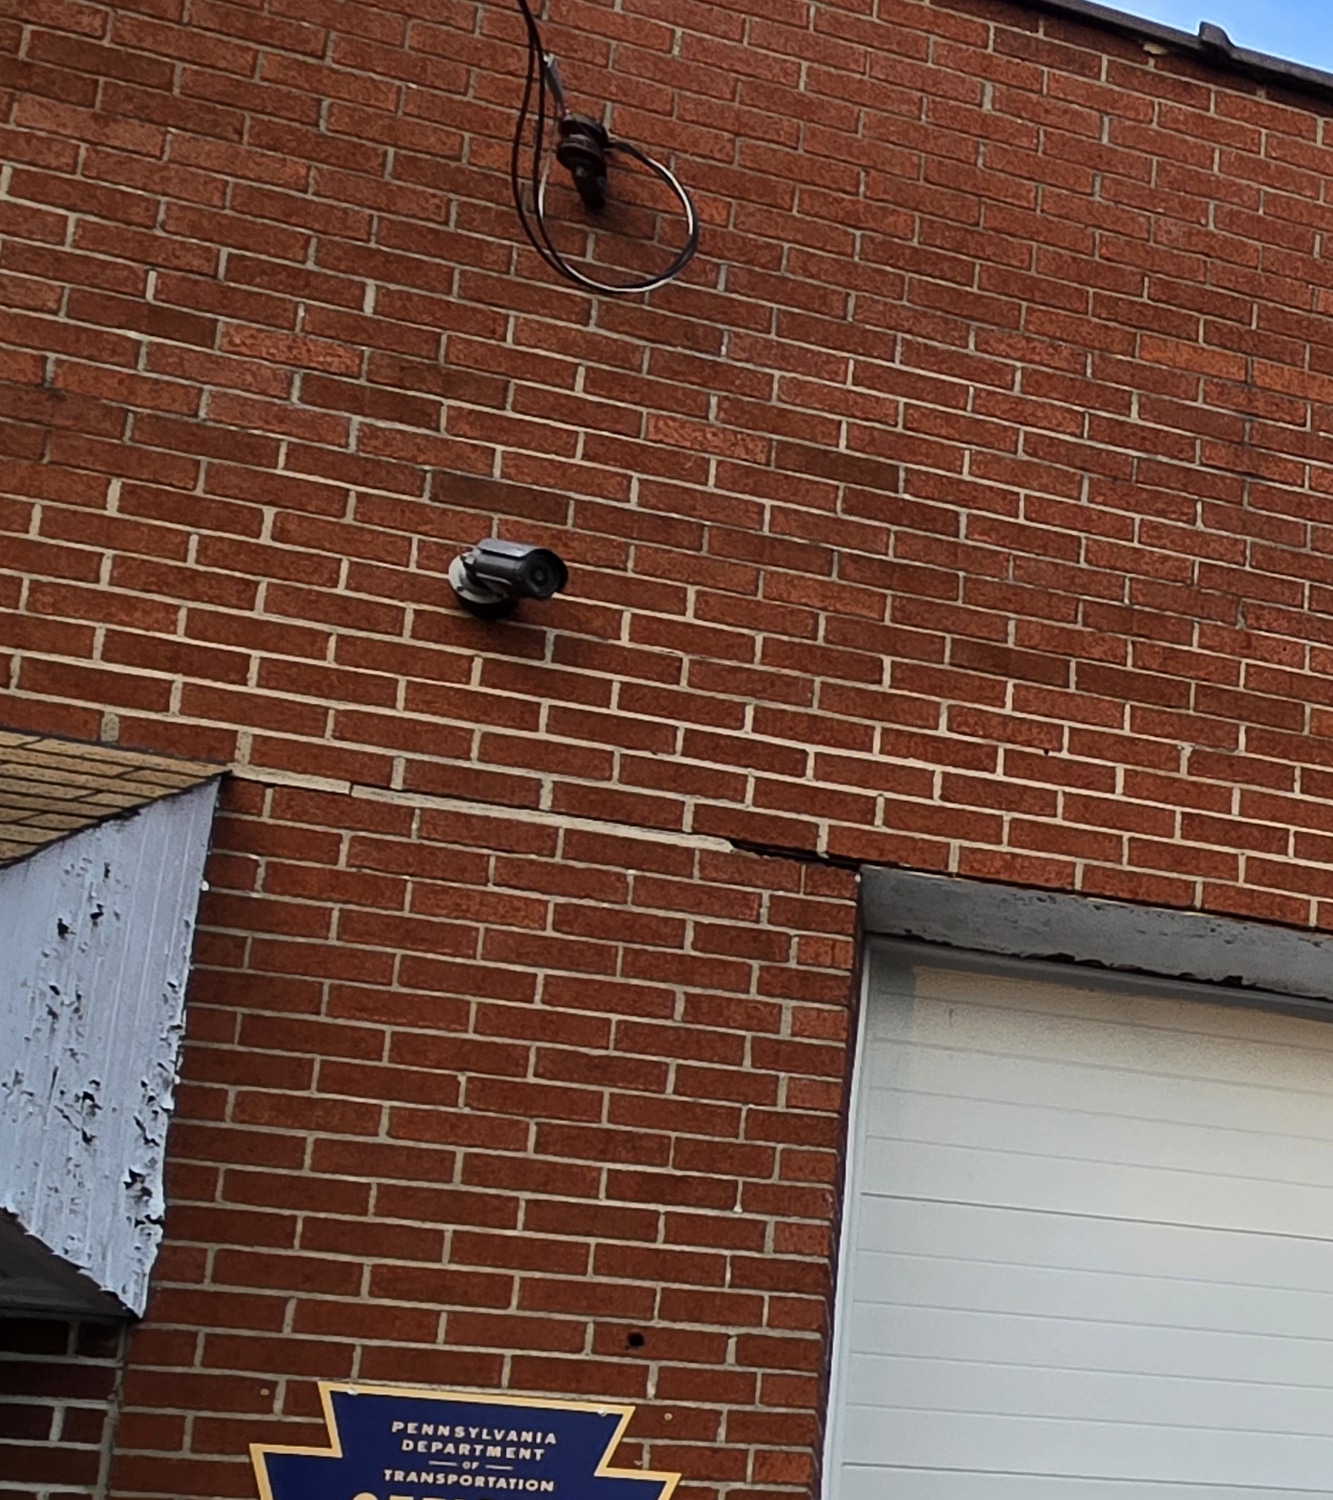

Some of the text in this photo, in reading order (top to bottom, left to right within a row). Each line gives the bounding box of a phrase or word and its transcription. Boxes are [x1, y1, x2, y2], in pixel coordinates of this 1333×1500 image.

[391, 1421, 557, 1444] PENNSYLVANIA
[401, 1439, 545, 1461] DEPARTMENT
[462, 1461, 480, 1470] OF
[383, 1469, 555, 1492] TRANSPORTATION
